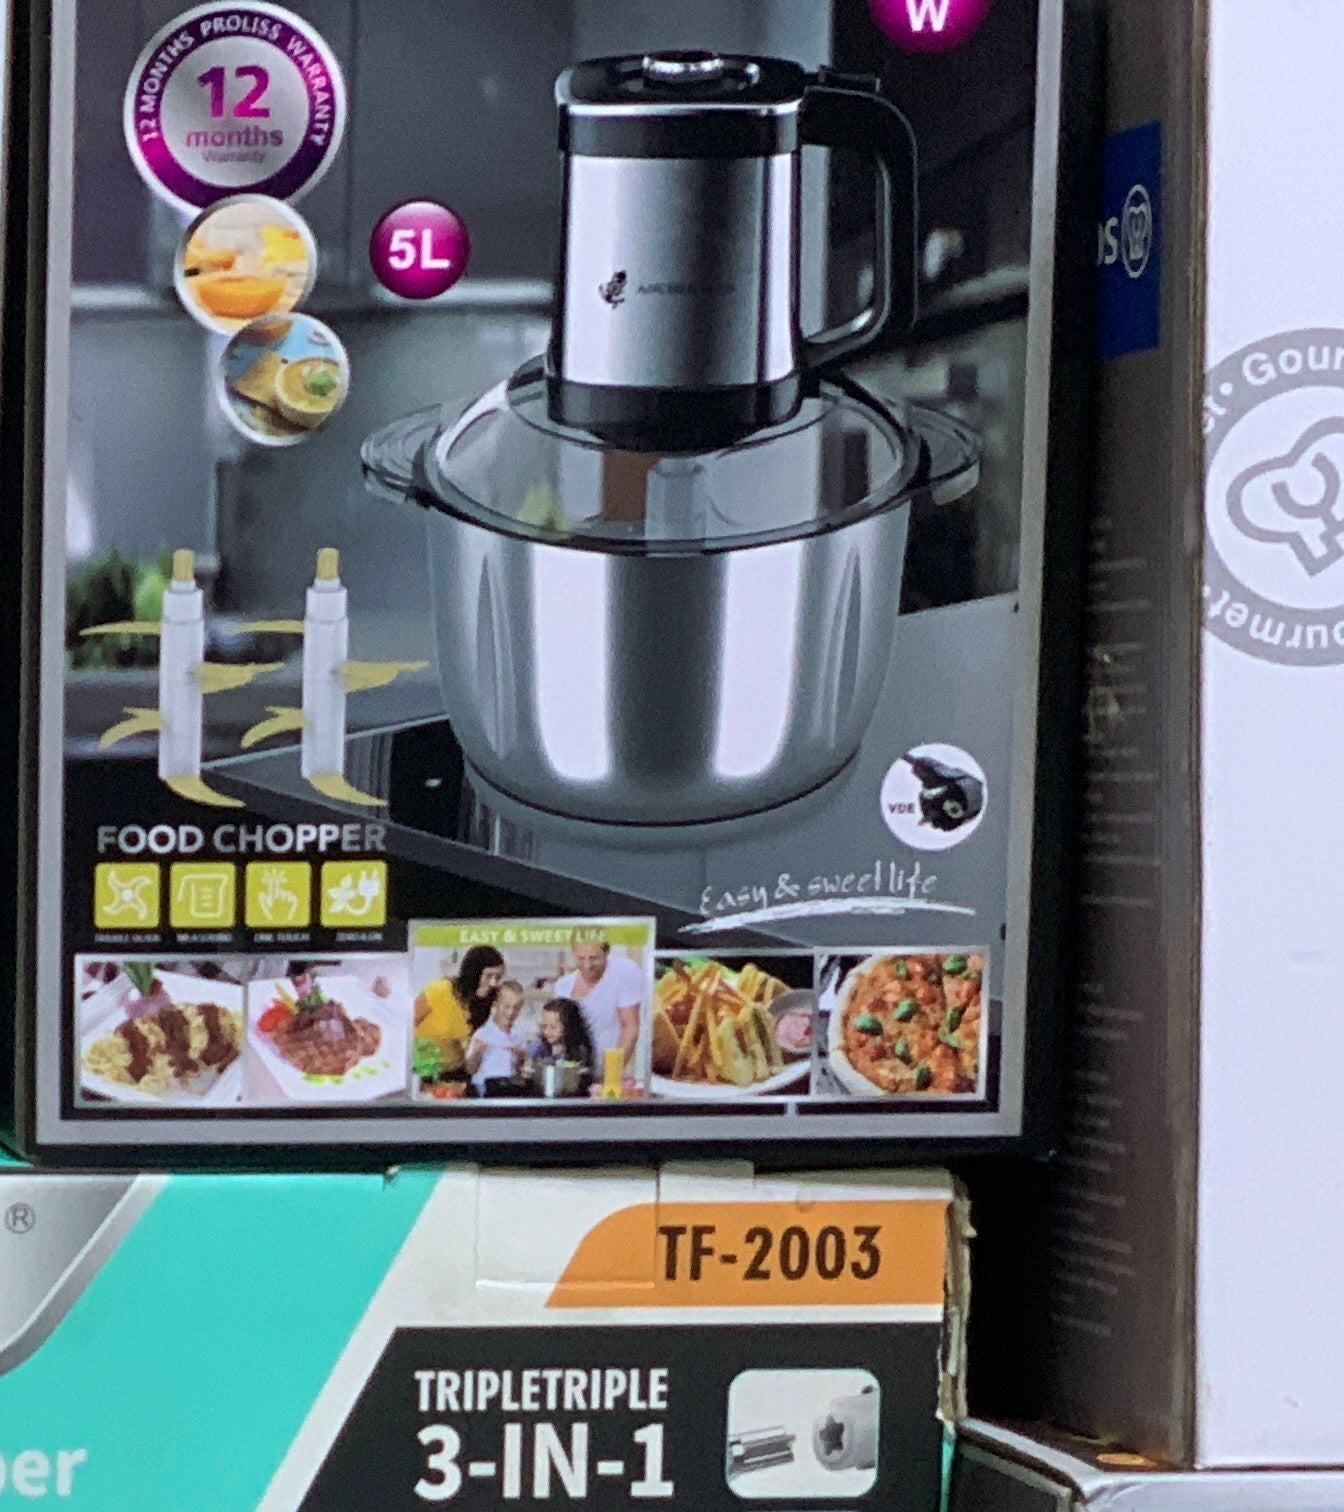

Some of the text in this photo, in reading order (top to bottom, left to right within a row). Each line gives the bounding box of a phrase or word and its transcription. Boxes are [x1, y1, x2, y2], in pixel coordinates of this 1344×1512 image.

[138, 30, 196, 115] MONTHS
[199, 14, 283, 41] PROLISS
[286, 34, 333, 148] WARRANTY
[196, 64, 271, 119] 12
[185, 125, 284, 148] months
[387, 227, 452, 274] 5L
[96, 823, 388, 855] FOOD CHOPPER
[776, 872, 800, 897] &
[460, 928, 501, 945] EASY
[519, 928, 572, 945] SWEET
[657, 1223, 884, 1282] TF-2003
[414, 1367, 670, 1413] TRIPLETRIPLE
[413, 1420, 676, 1501] 3-IN-1
